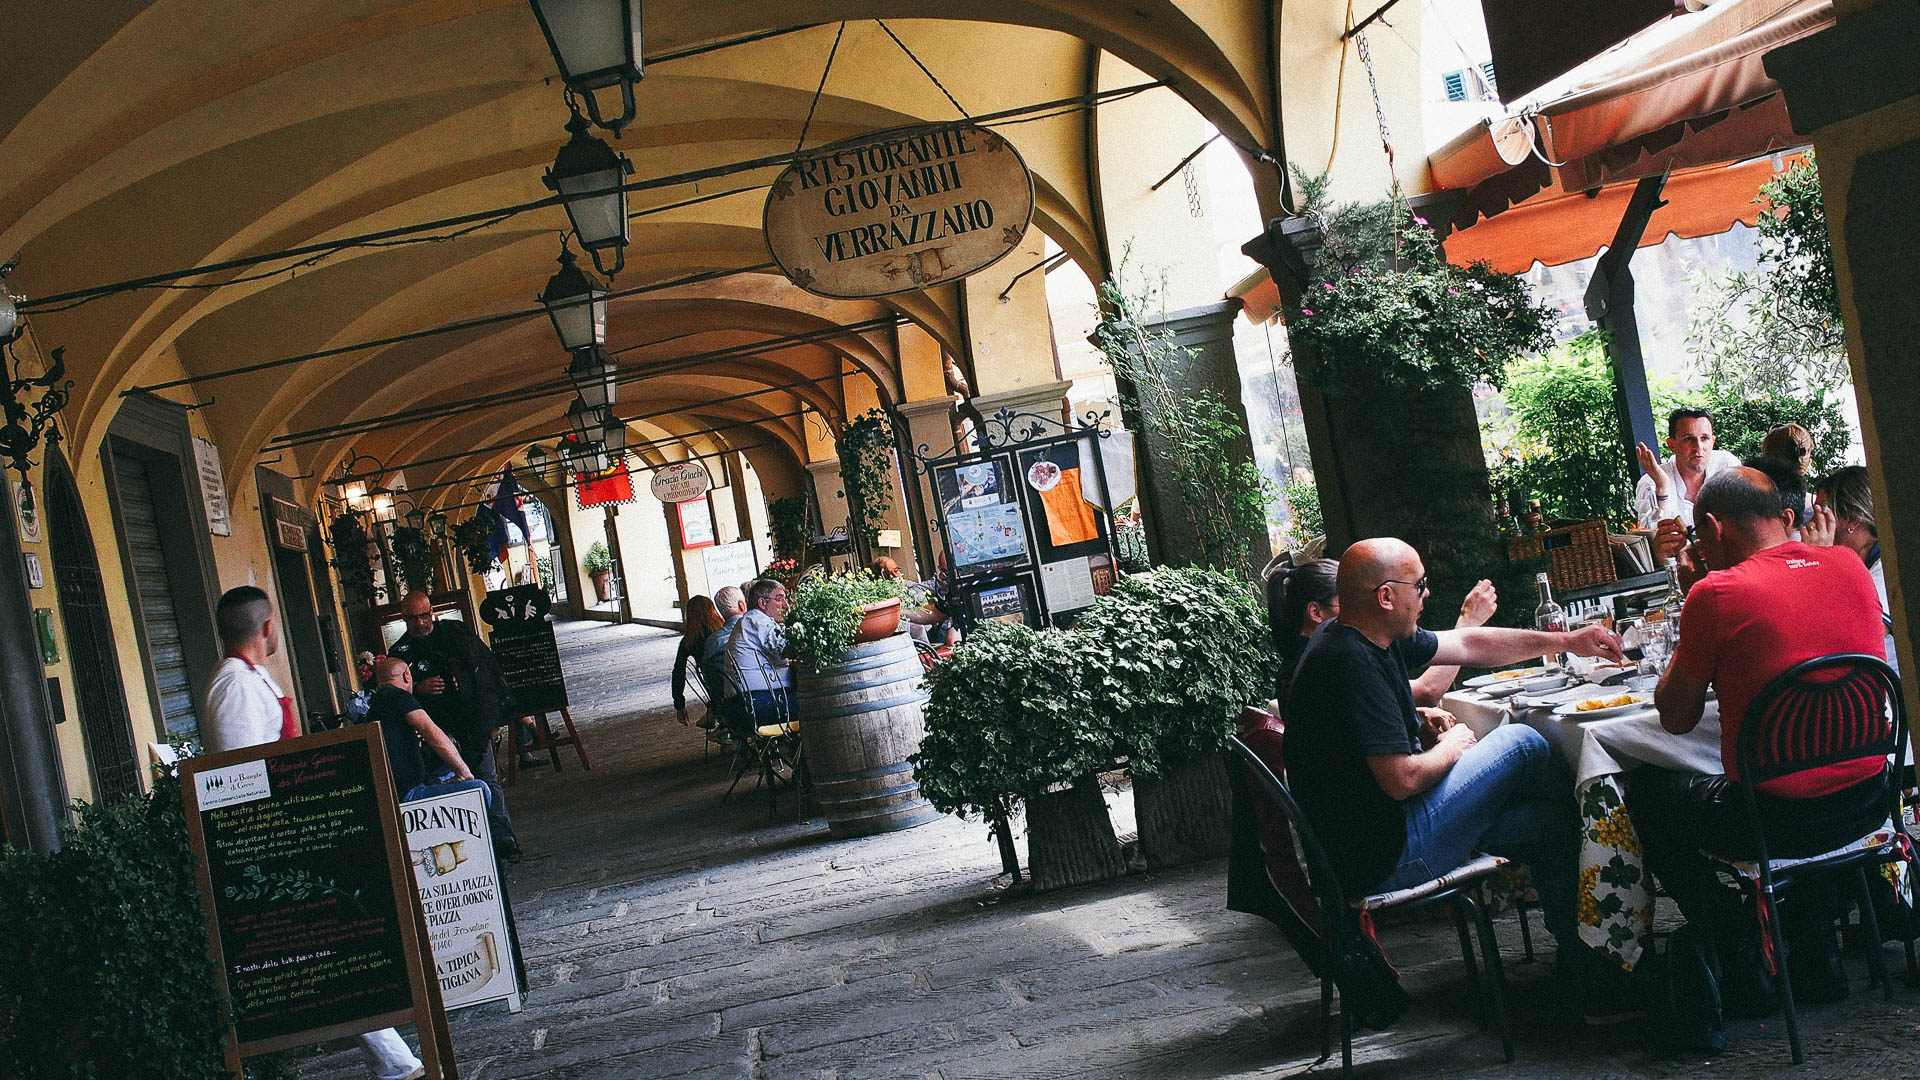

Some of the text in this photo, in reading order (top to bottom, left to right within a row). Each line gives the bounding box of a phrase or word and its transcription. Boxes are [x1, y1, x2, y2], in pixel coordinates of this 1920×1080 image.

[799, 127, 976, 191] RISTORANTE
[824, 160, 962, 218] GIOVANNI
[889, 203, 912, 218] DA
[812, 199, 994, 263] VERRAZZANO
[655, 475, 679, 486] Grazia
[218, 793, 246, 803] Commerciale
[246, 789, 267, 797] Naturale
[210, 809, 228, 821] Nella
[231, 805, 253, 816] nostra
[257, 801, 280, 811] cucina
[216, 819, 239, 831] freschi
[235, 835, 268, 847] degustare
[276, 829, 296, 839] nostro
[330, 820, 342, 828] olio
[433, 881, 461, 898] SULLA
[463, 875, 494, 891] PIAZZA
[435, 888, 494, 912] OVERLOOKING
[429, 910, 461, 927] PIAZZA
[439, 929, 450, 939] del
[234, 965, 241, 974] I
[446, 950, 481, 973] TIPICA
